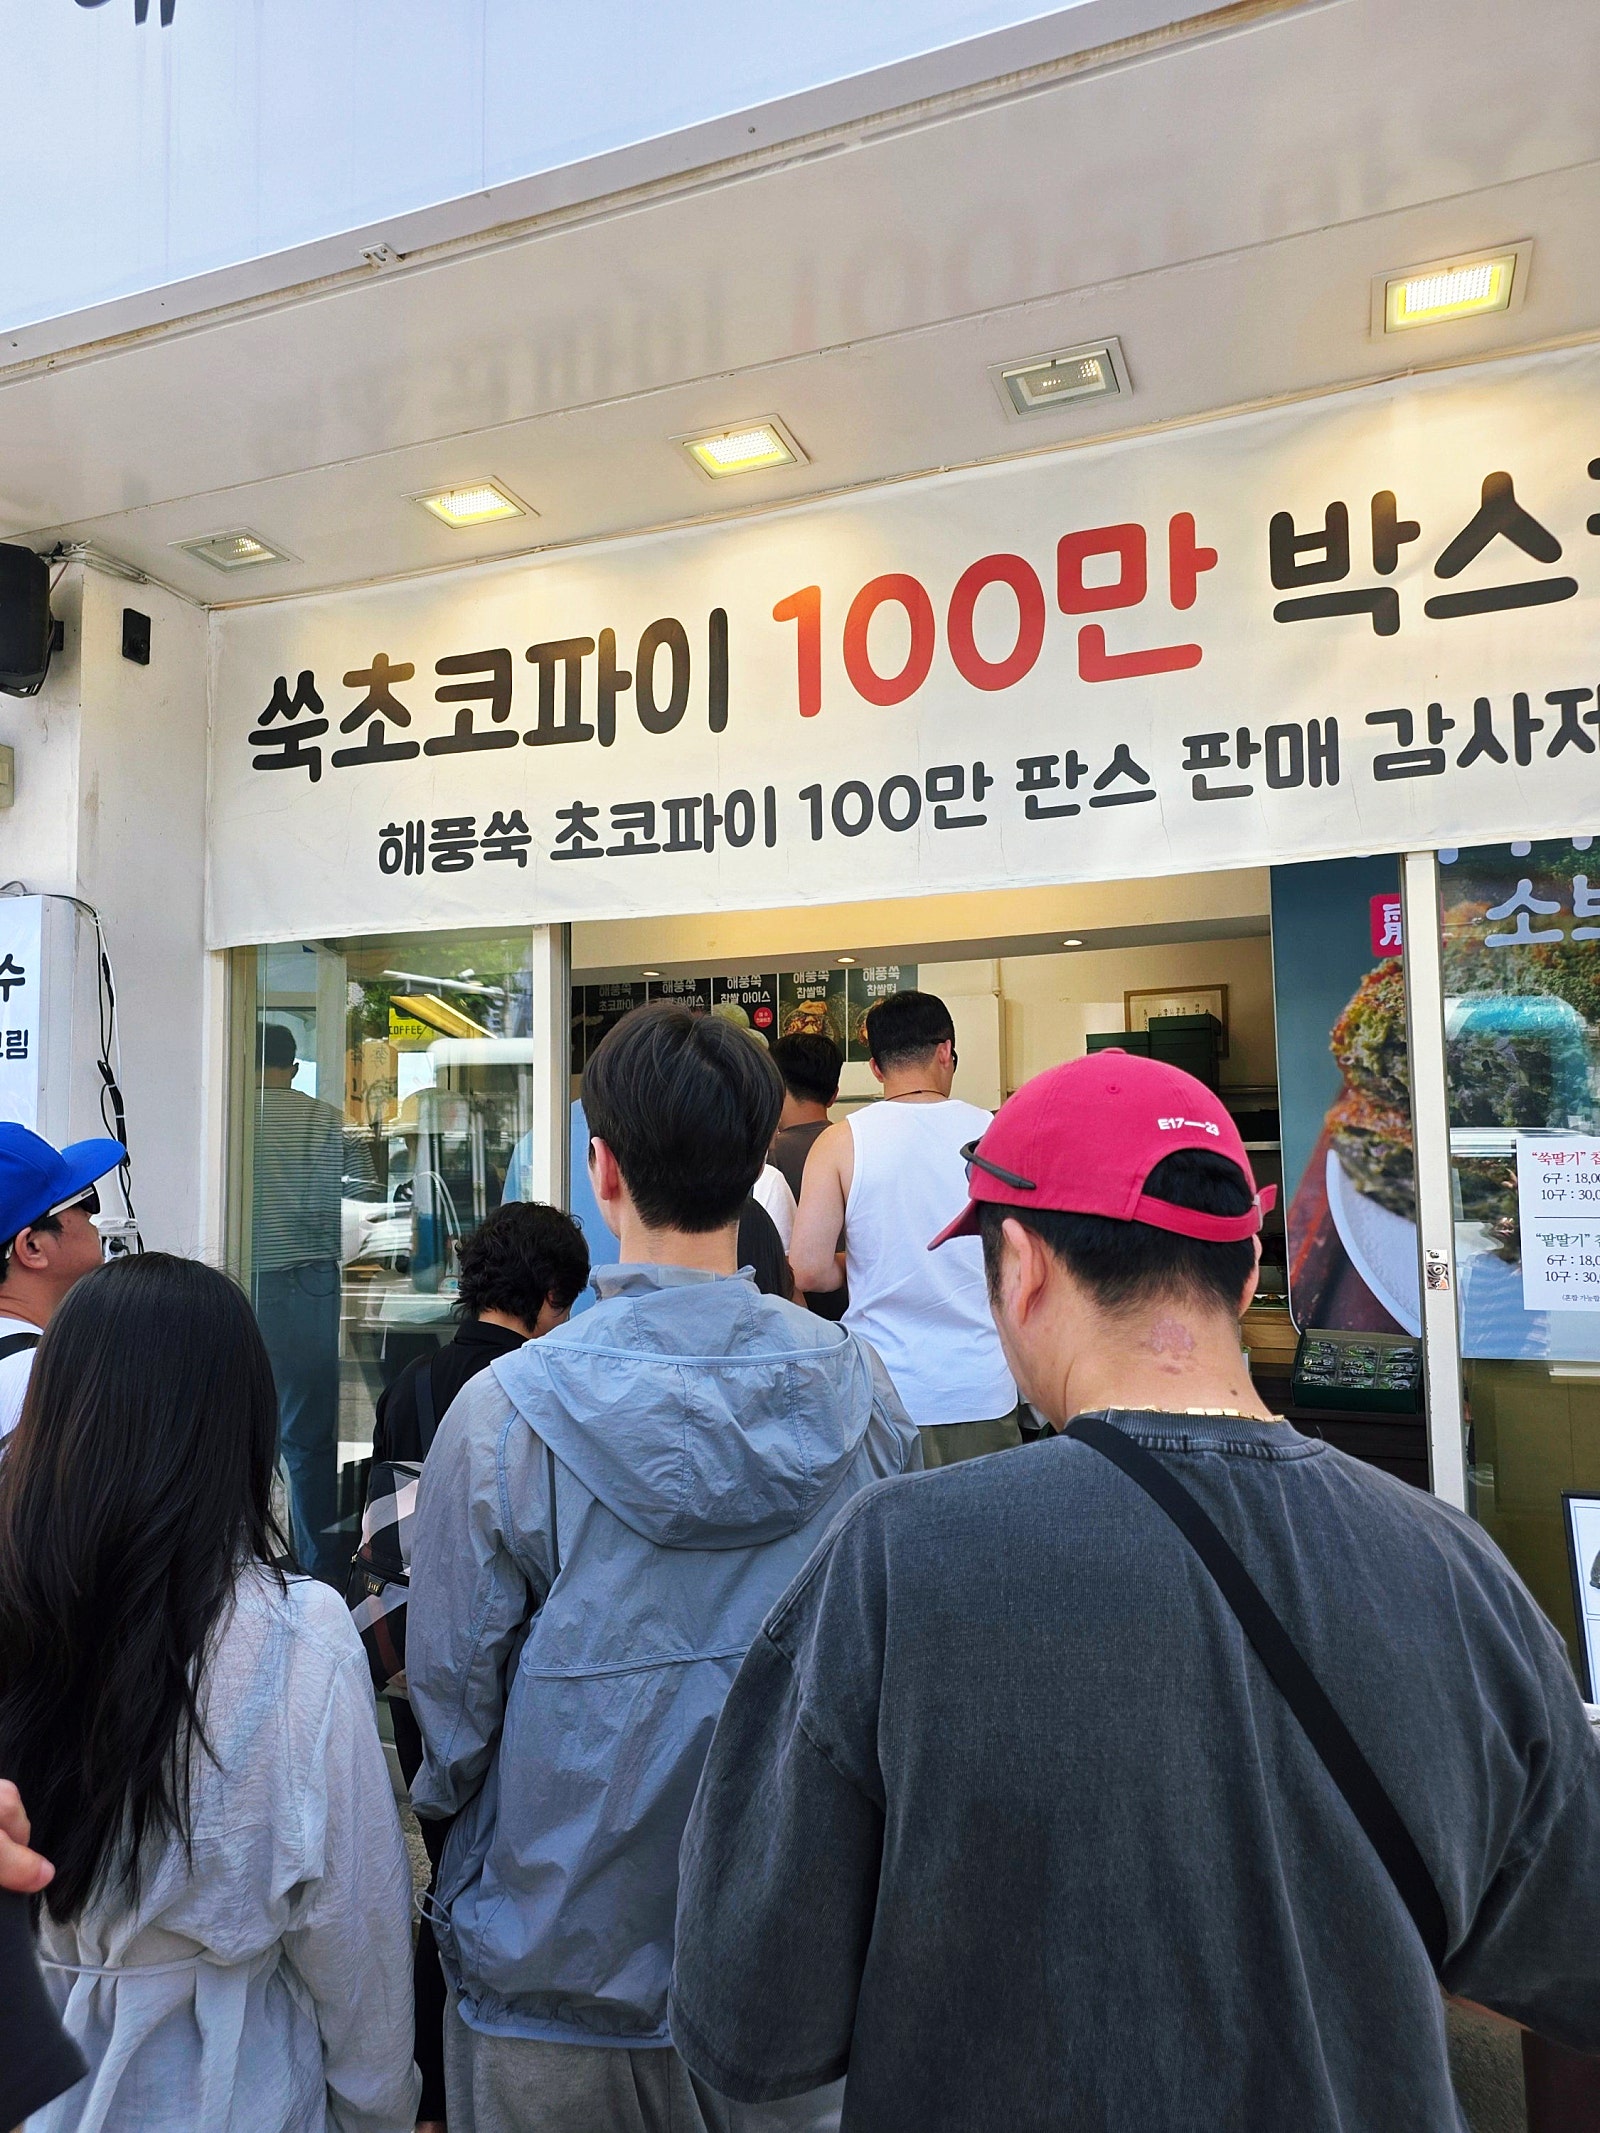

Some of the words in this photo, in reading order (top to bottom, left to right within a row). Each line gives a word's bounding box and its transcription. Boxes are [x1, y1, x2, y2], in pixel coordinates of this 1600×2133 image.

[248, 608, 728, 782] 쑥초코파이
[773, 512, 1218, 717] 100만
[1270, 457, 1600, 637] 박스
[379, 810, 531, 875] 해풍쑥
[550, 786, 776, 860] 초코파이
[797, 762, 993, 840] 100만
[1016, 744, 1156, 820] 판스
[1182, 717, 1339, 800] 판매
[742, 991, 771, 1003] 아이스
[796, 986, 826, 999] 찹쌀떡
[388, 1025, 423, 1035] COFFEE
[0, 1029, 29, 1060] 림
[1543, 1172, 1563, 1185] 6구
[1541, 1189, 1567, 1201] 10구
[1547, 1254, 1567, 1267] 6구
[1545, 1271, 1571, 1283] 10구
[1582, 1271, 1600, 1284] 30,
